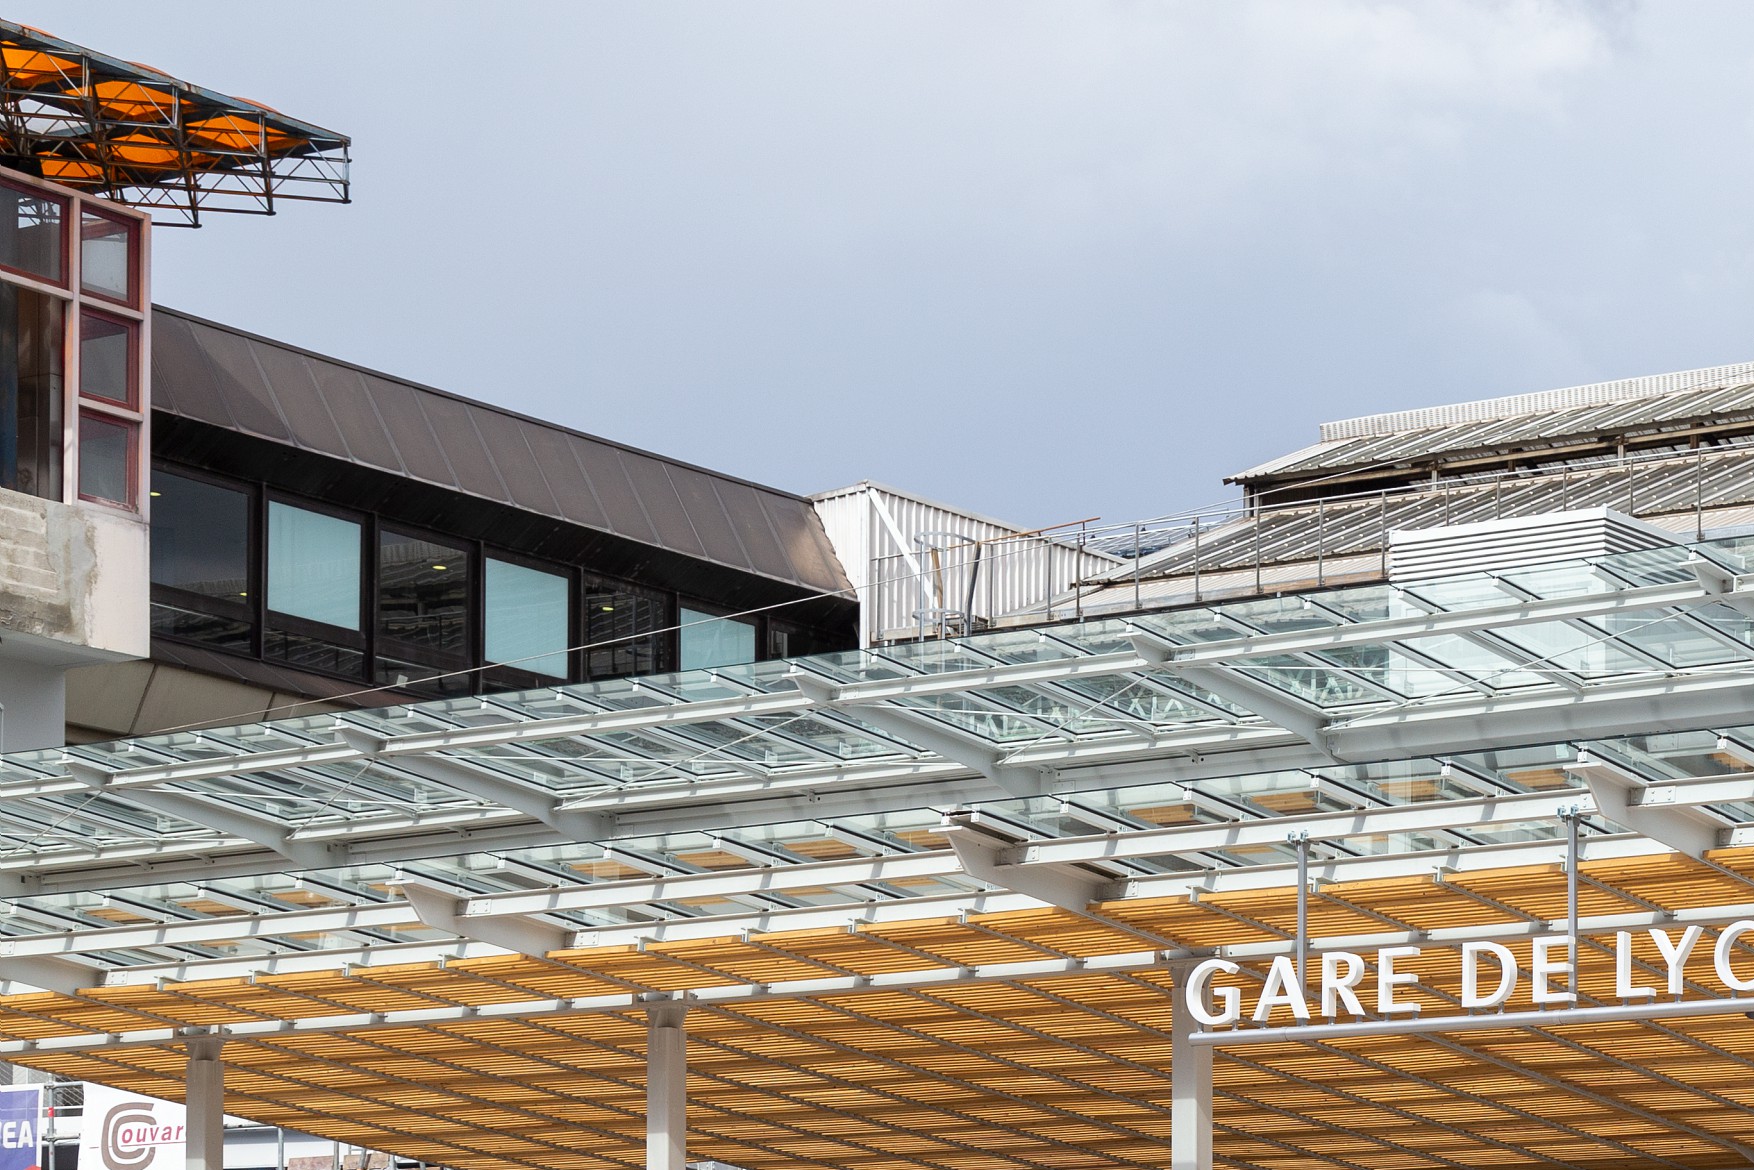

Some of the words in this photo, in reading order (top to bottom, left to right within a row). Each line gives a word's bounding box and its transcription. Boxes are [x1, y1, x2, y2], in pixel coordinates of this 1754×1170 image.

[1185, 946, 1422, 1025] GARE
[1461, 935, 1577, 1008] DE
[0, 1121, 33, 1149] EA
